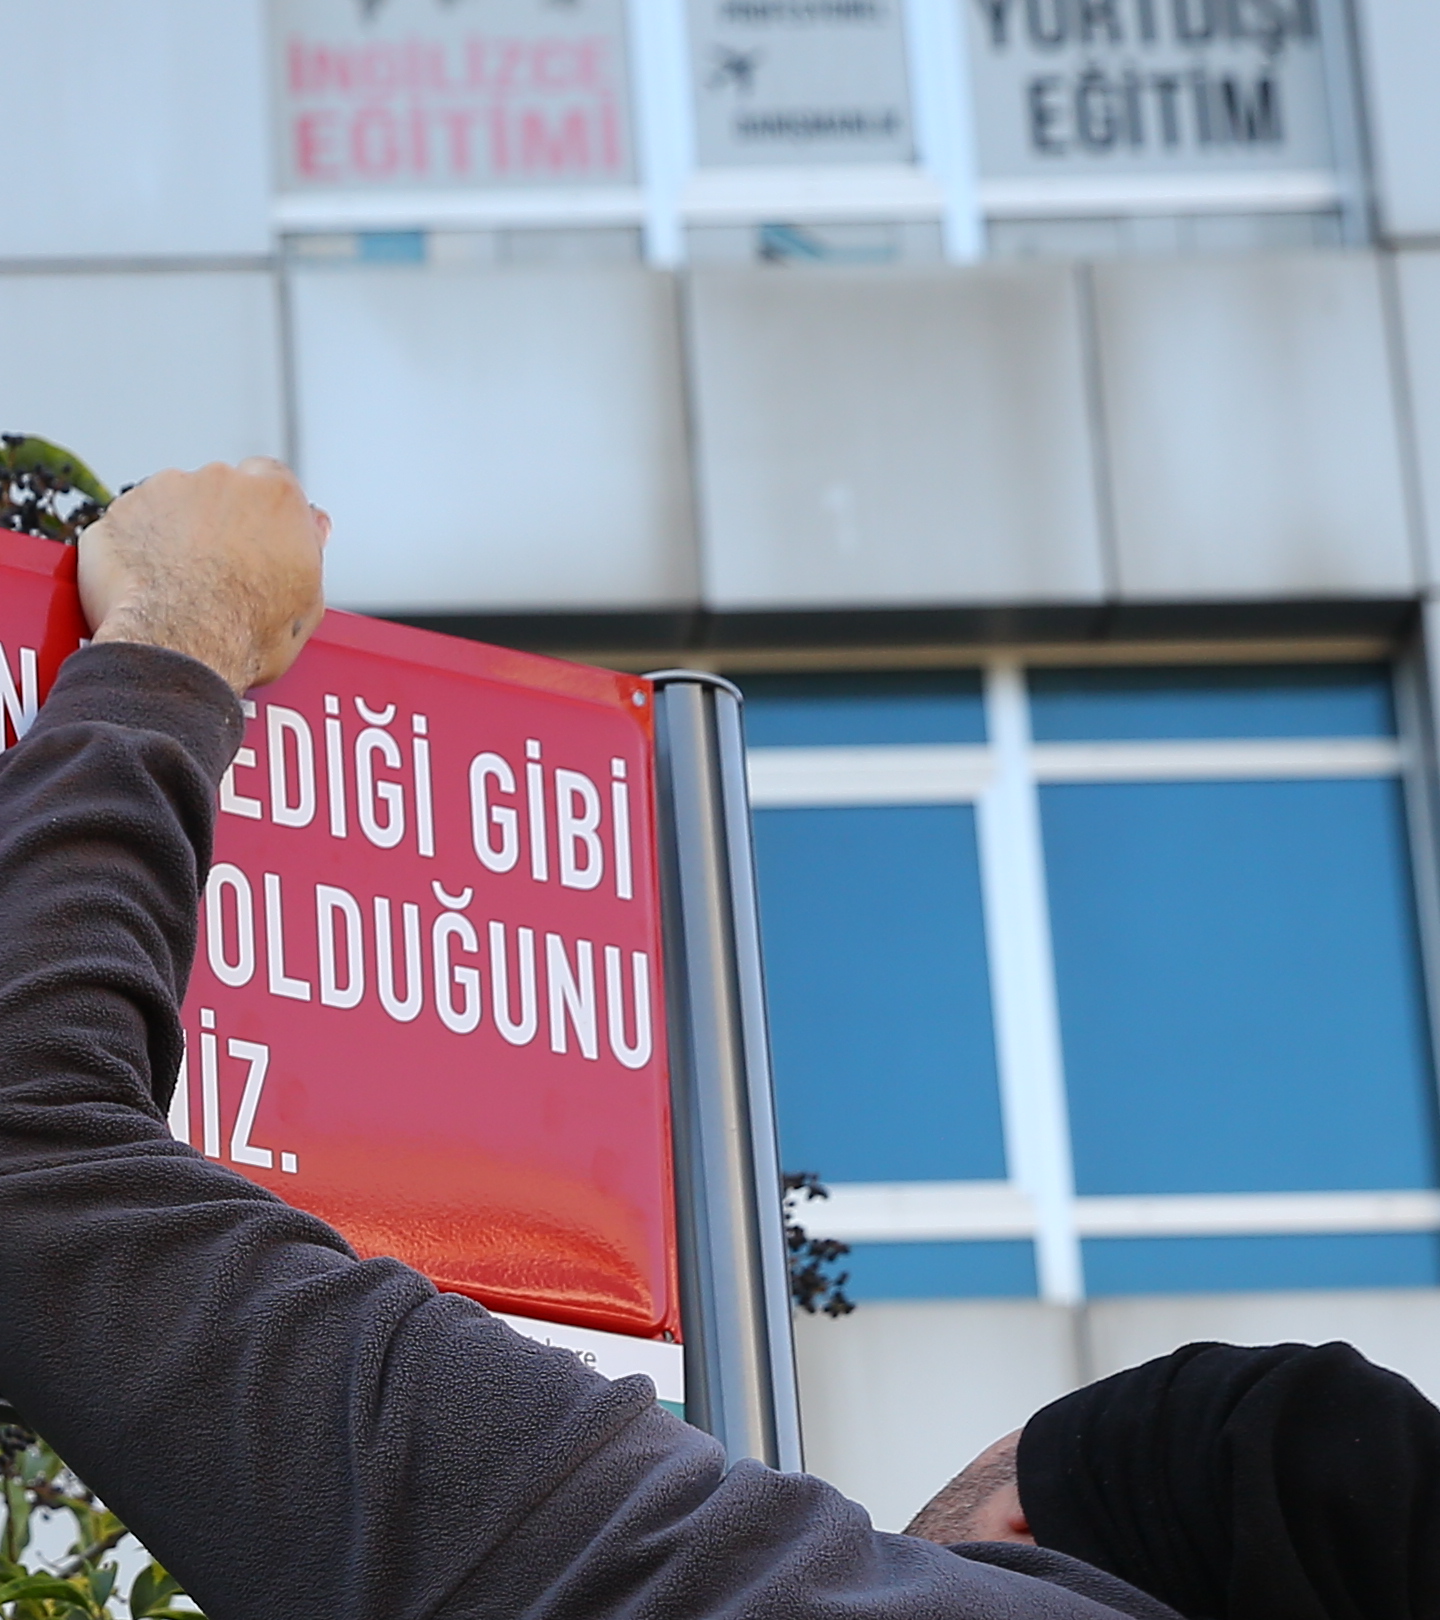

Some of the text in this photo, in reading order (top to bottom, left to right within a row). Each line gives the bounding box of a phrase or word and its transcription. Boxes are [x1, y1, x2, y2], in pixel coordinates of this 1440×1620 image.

[296, 90, 622, 182] EĞİTİMİ
[1028, 62, 1284, 154] EĞİTİM
[468, 738, 634, 901] GİBİ
[206, 862, 654, 1070] OLDUĞUNU
